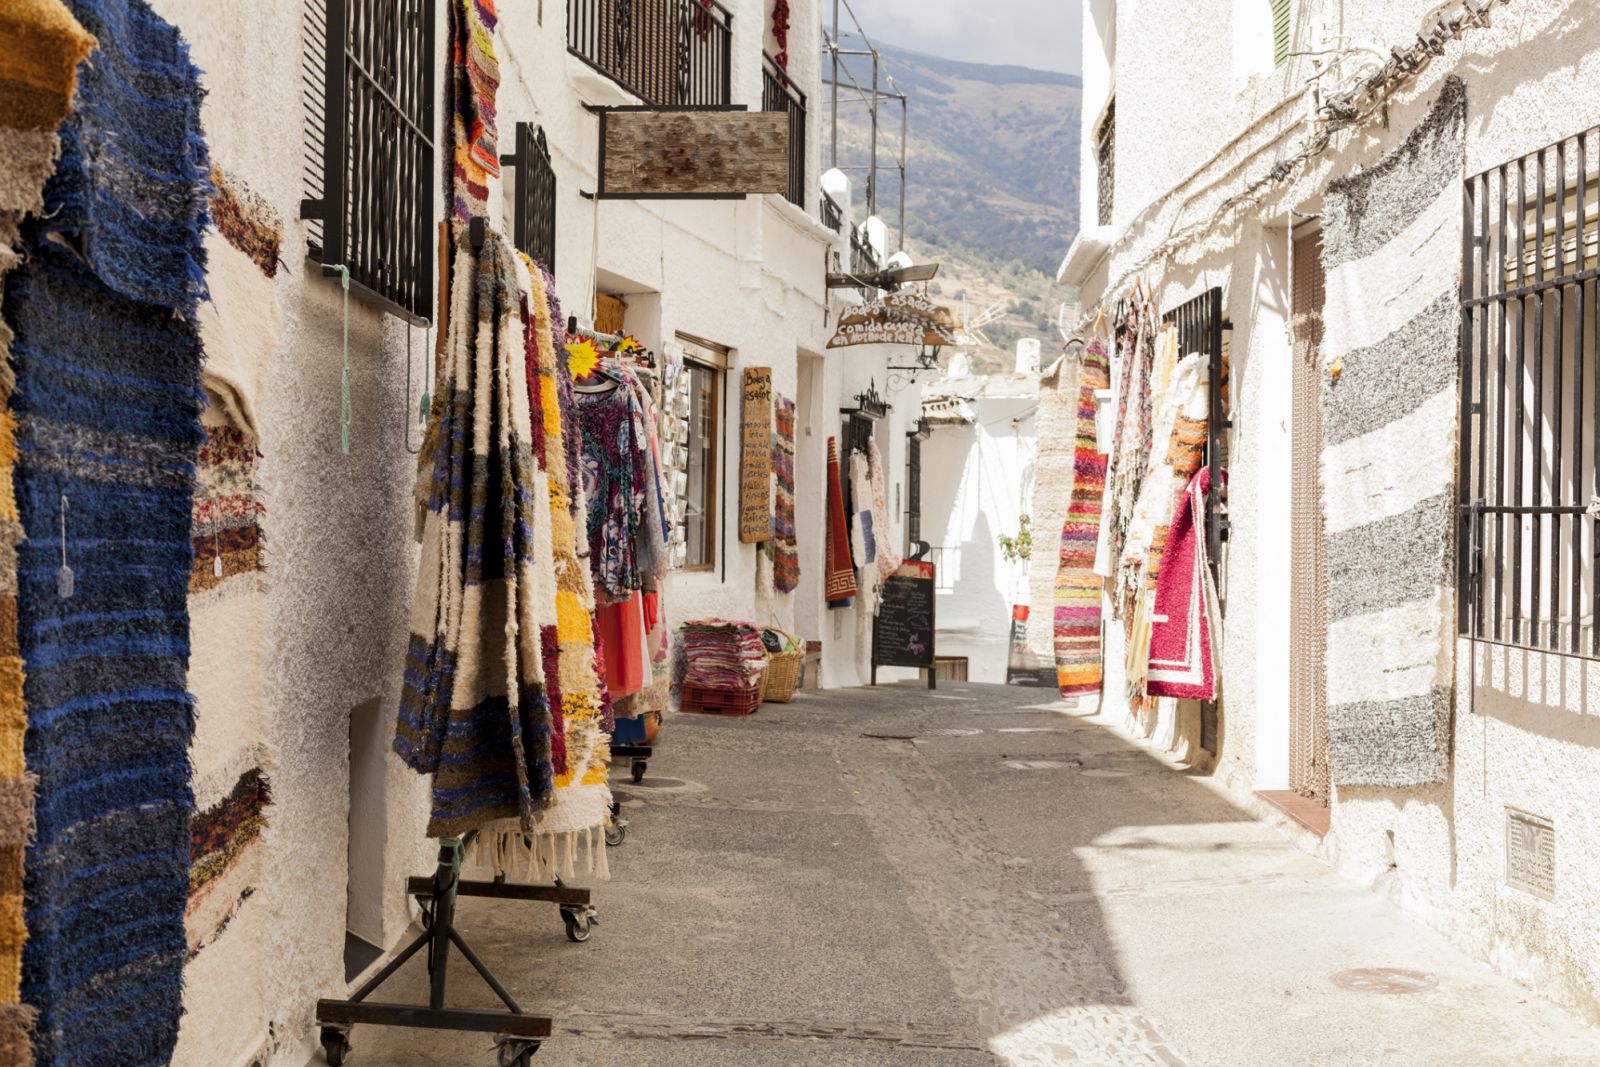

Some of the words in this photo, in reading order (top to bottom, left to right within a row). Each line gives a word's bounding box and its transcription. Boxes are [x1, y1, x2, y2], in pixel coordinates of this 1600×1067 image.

[841, 298, 886, 320] Bodega
[838, 318, 883, 335] comida
[832, 335, 848, 345] en
